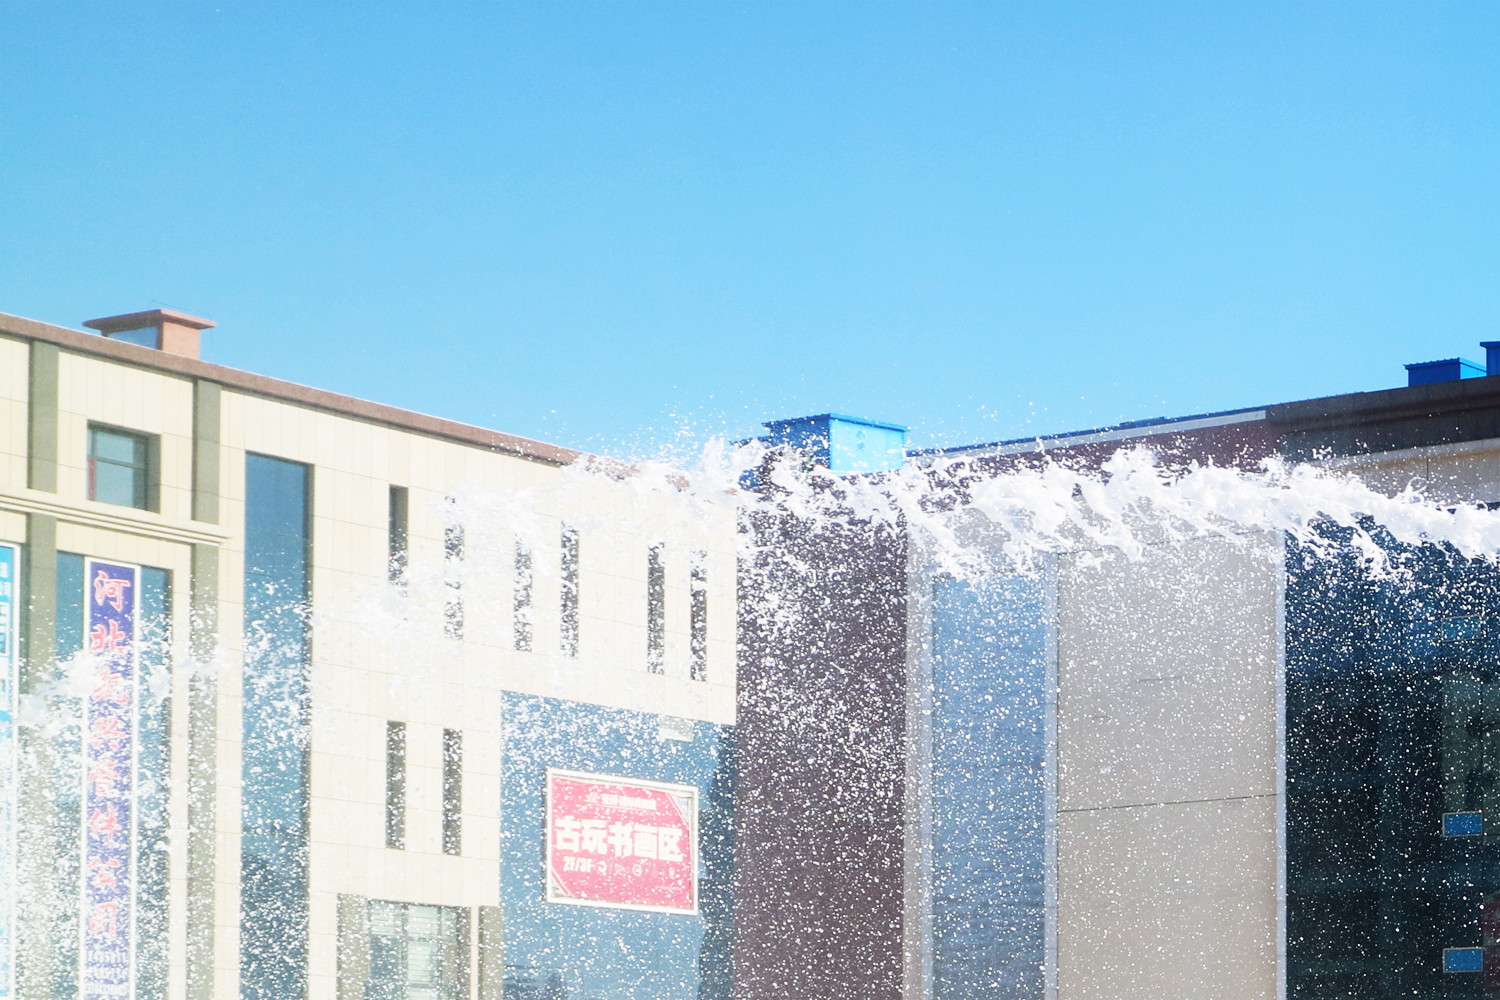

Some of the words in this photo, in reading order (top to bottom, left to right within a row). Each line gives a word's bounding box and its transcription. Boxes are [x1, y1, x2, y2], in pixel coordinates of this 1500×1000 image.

[555, 815, 683, 862] 古玩书画区
